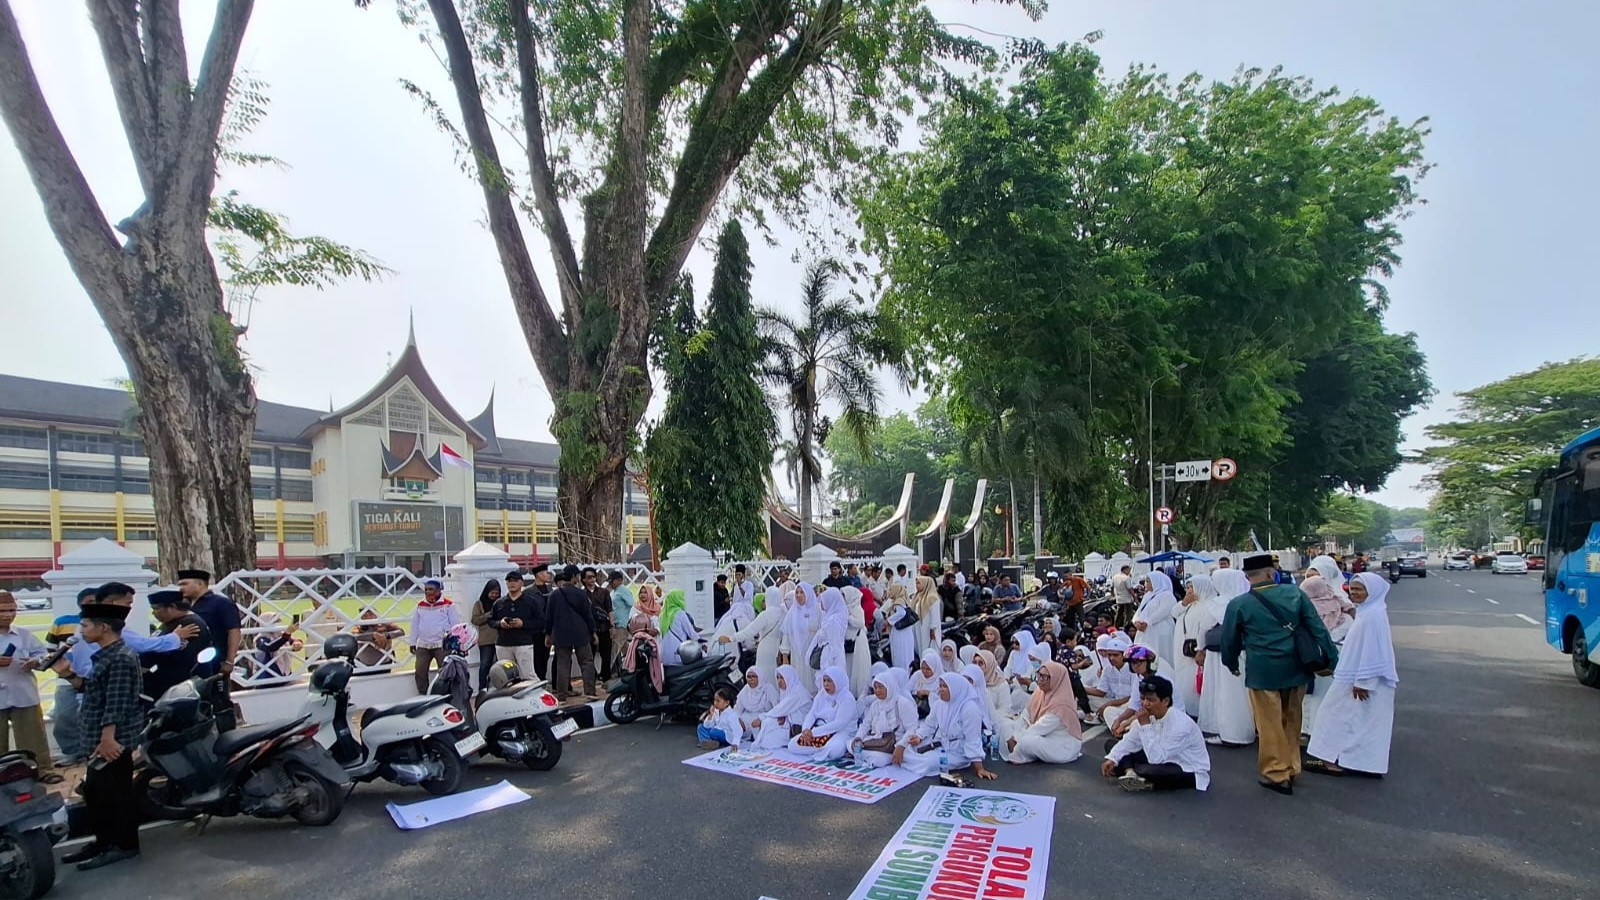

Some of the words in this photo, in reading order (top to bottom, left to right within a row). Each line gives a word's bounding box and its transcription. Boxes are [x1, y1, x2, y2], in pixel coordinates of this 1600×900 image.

[364, 513, 391, 524] TIGA
[393, 512, 421, 522] KALI
[749, 763, 792, 774] SATU
[789, 771, 852, 787] ORMAS
[852, 782, 886, 794] MU
[832, 770, 897, 787] MILIK
[935, 791, 962, 818] ANMB
[902, 820, 954, 849] MUI
[863, 849, 940, 900] SUMB
[925, 824, 998, 900] PENGUKU
[983, 845, 1034, 900] TOLA
